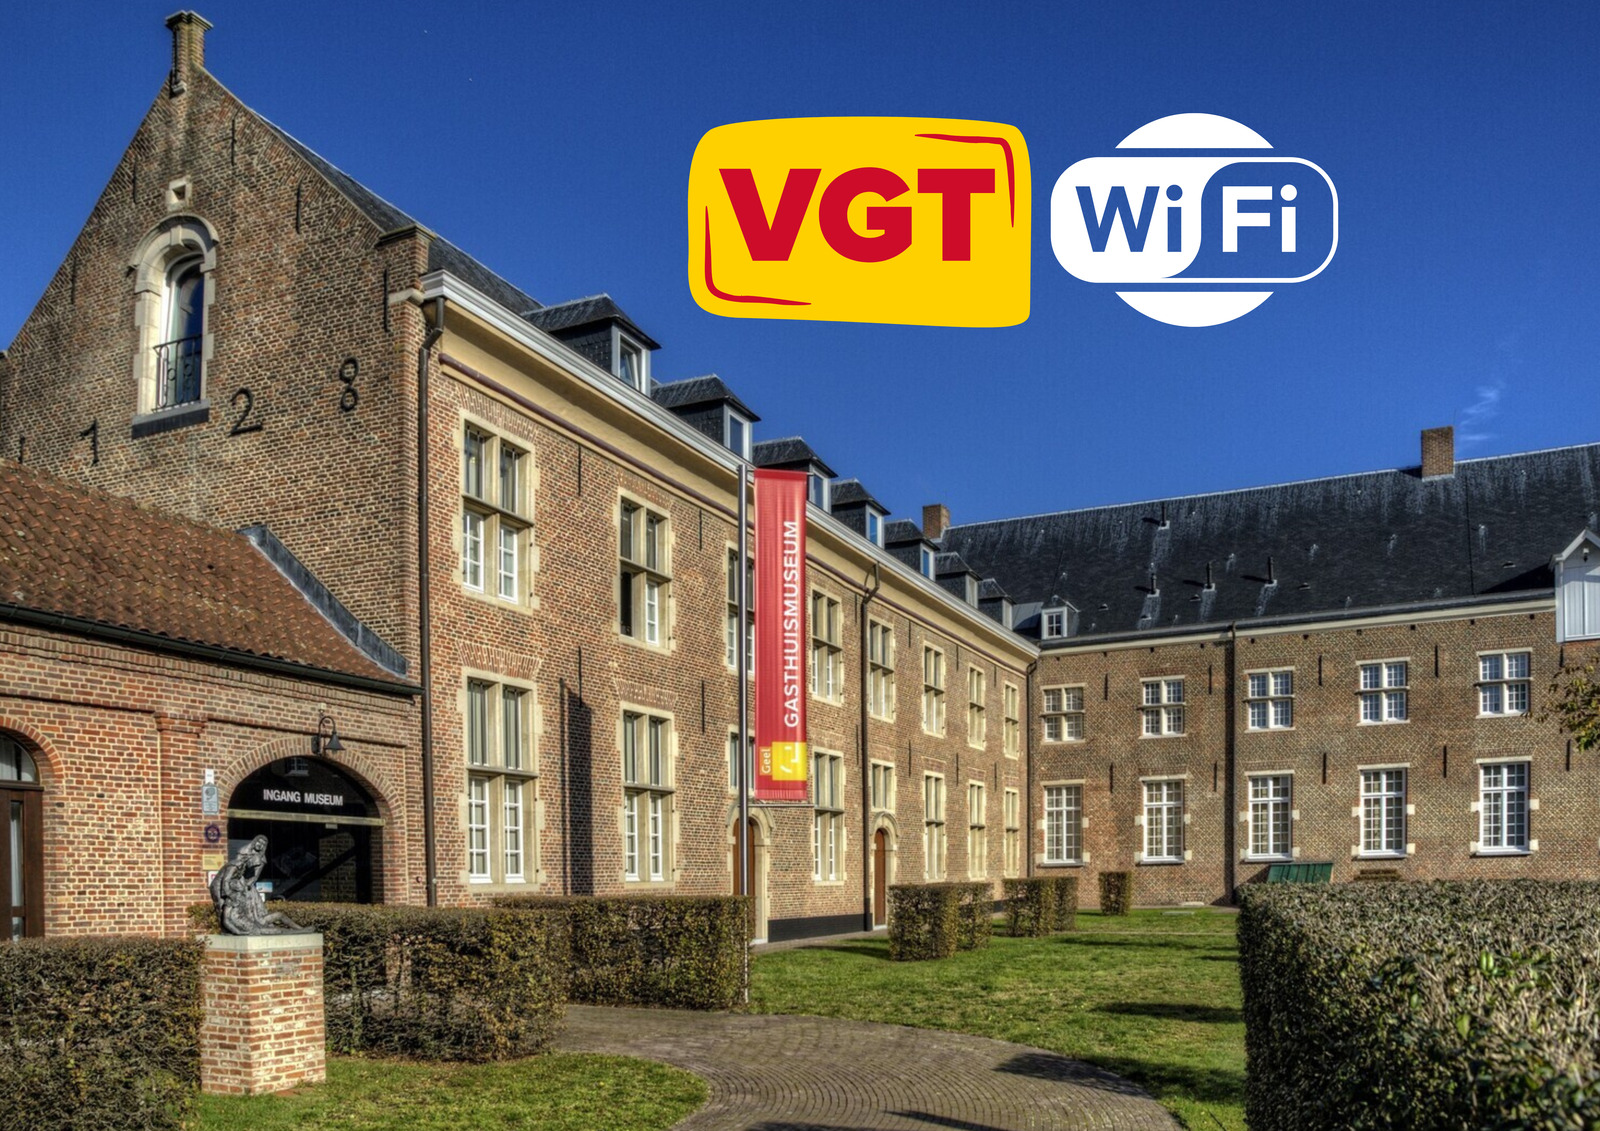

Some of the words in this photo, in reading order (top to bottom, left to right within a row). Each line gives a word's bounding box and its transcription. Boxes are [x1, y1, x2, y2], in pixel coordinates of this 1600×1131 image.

[783, 521, 799, 728] GASTHUISMUSEUM
[761, 748, 771, 774] Geel
[263, 789, 301, 803] INGANG
[304, 793, 343, 806] MUSEUM
